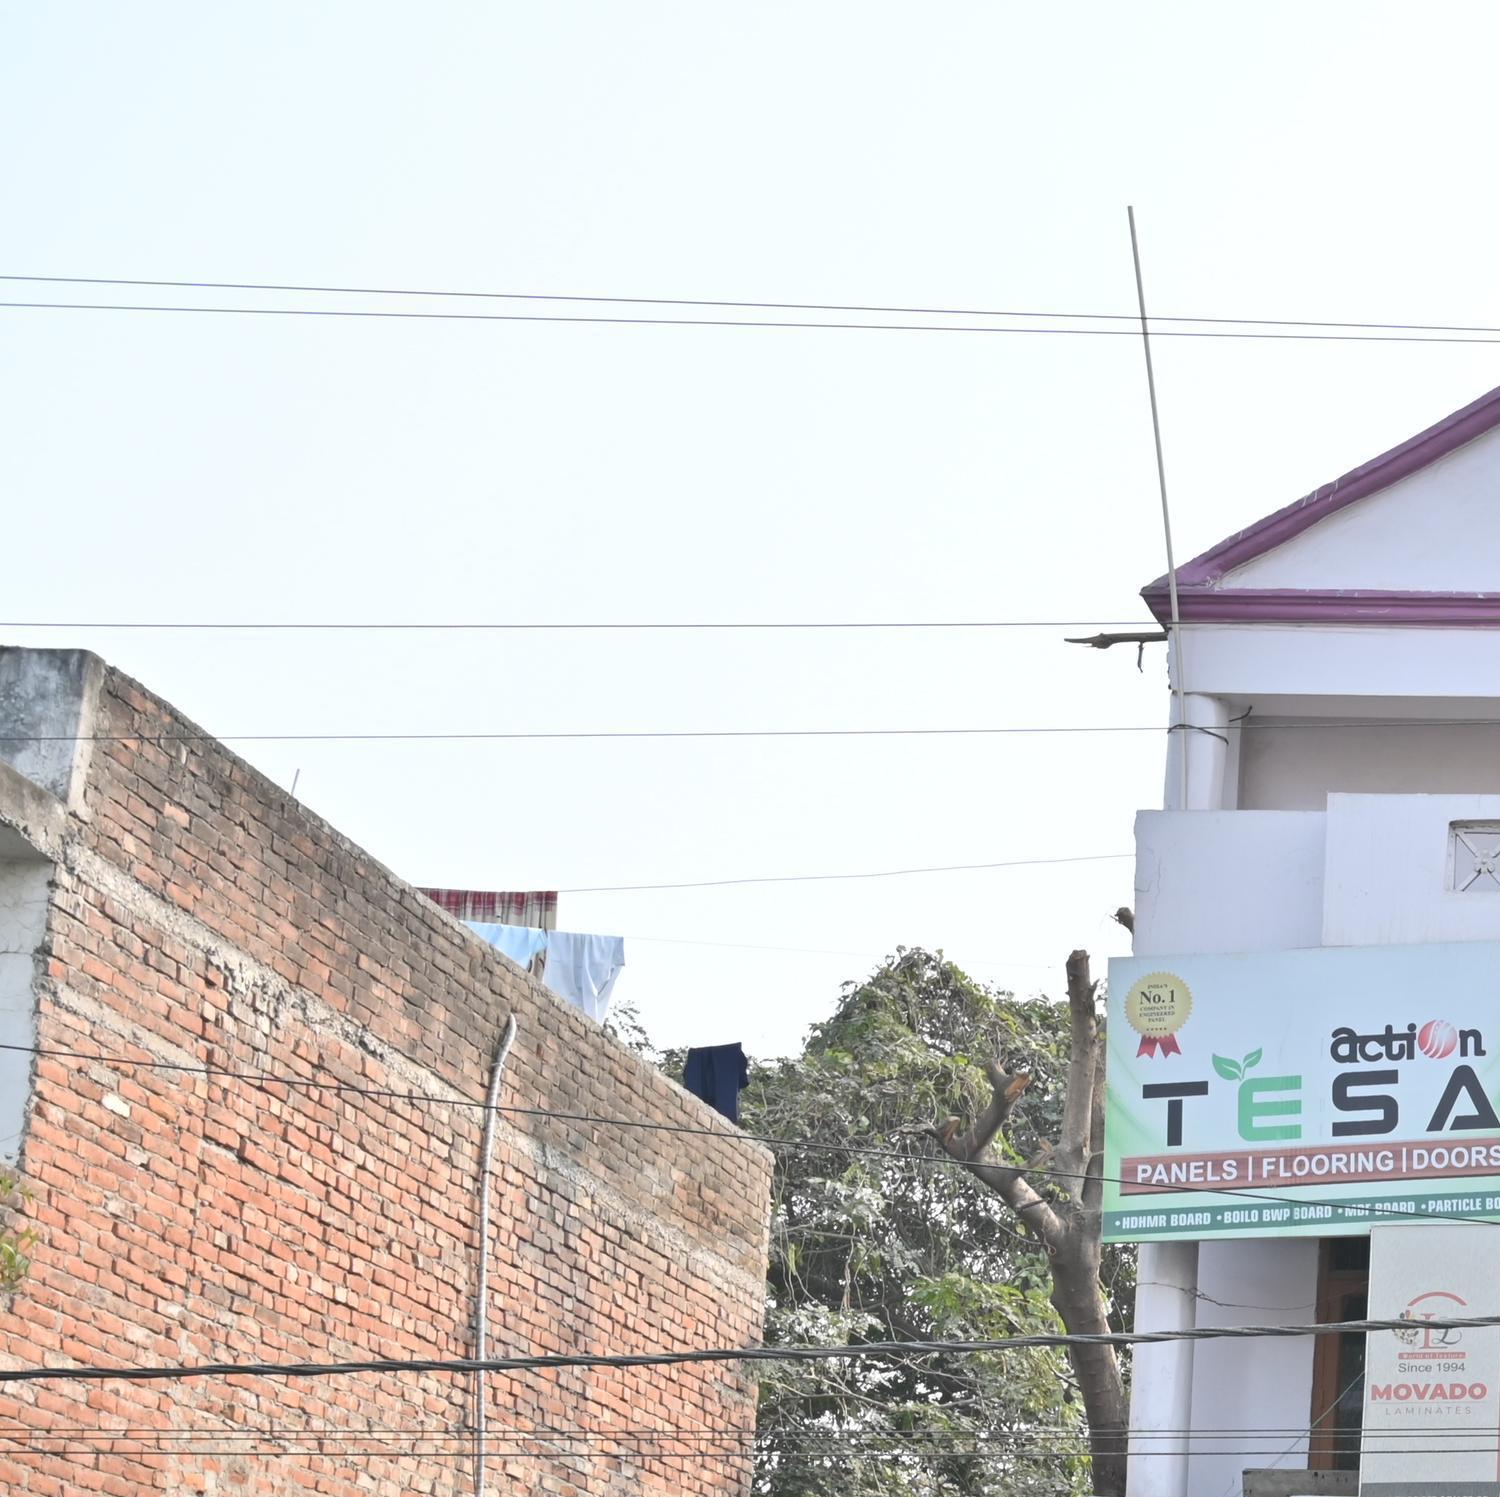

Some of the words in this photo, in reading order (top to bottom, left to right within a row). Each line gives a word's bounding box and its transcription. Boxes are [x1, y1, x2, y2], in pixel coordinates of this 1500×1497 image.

[1140, 990, 1165, 1005] No.
[1137, 1159, 1238, 1184] PANELS
[1262, 1151, 1394, 1179] FLOORING
[1170, 1213, 1211, 1227] BOARD
[1293, 1206, 1332, 1220] BOARD
[1428, 1198, 1484, 1213] PARTICLE
[1398, 1362, 1432, 1373] Since
[1437, 1362, 1466, 1372] 1994
[1371, 1383, 1488, 1401] MOVADO
[1386, 1406, 1472, 1415] LAMINATES
